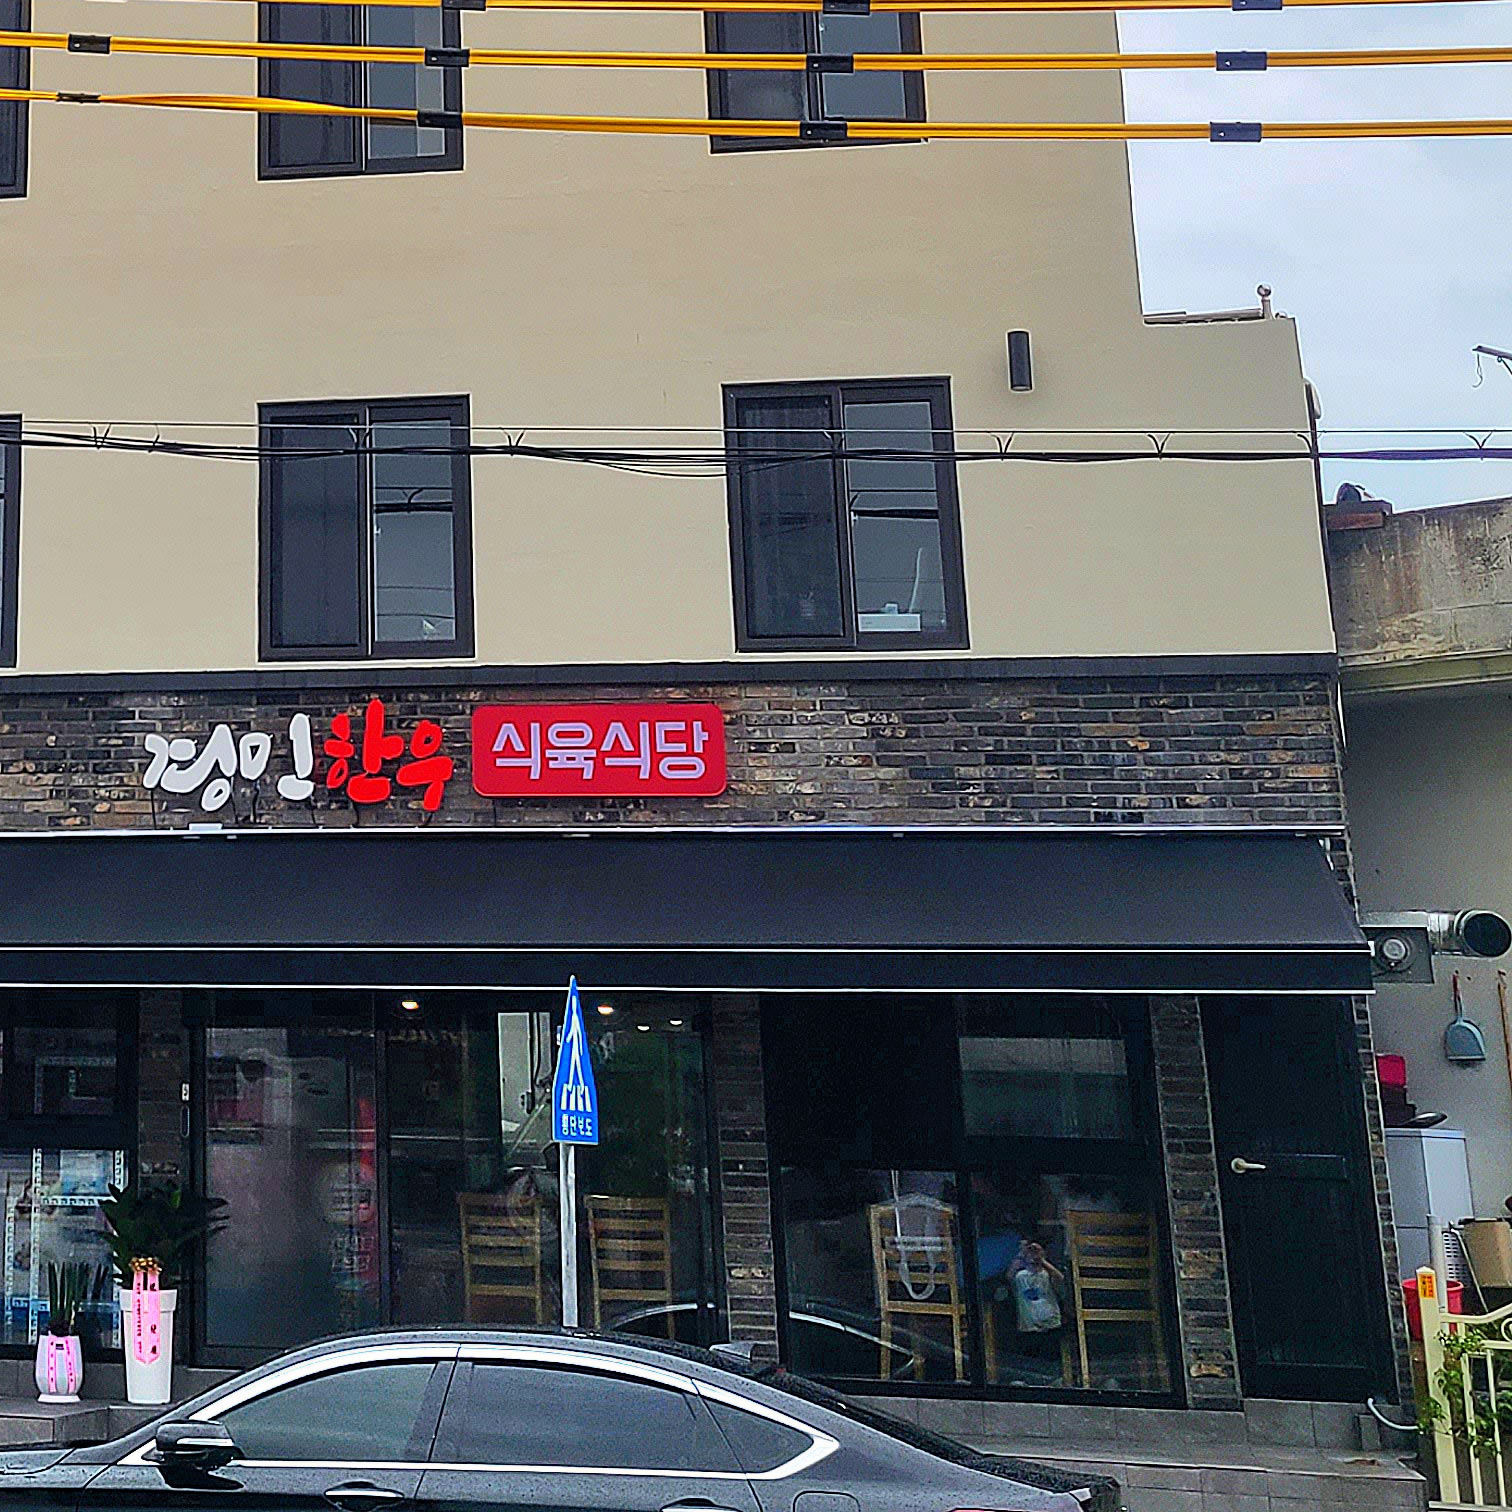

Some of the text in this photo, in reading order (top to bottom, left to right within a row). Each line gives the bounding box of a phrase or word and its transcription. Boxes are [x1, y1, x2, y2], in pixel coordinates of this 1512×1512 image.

[323, 698, 453, 812] 한우
[491, 721, 709, 780] 식육식당
[561, 1113, 593, 1137] 횡단보도
